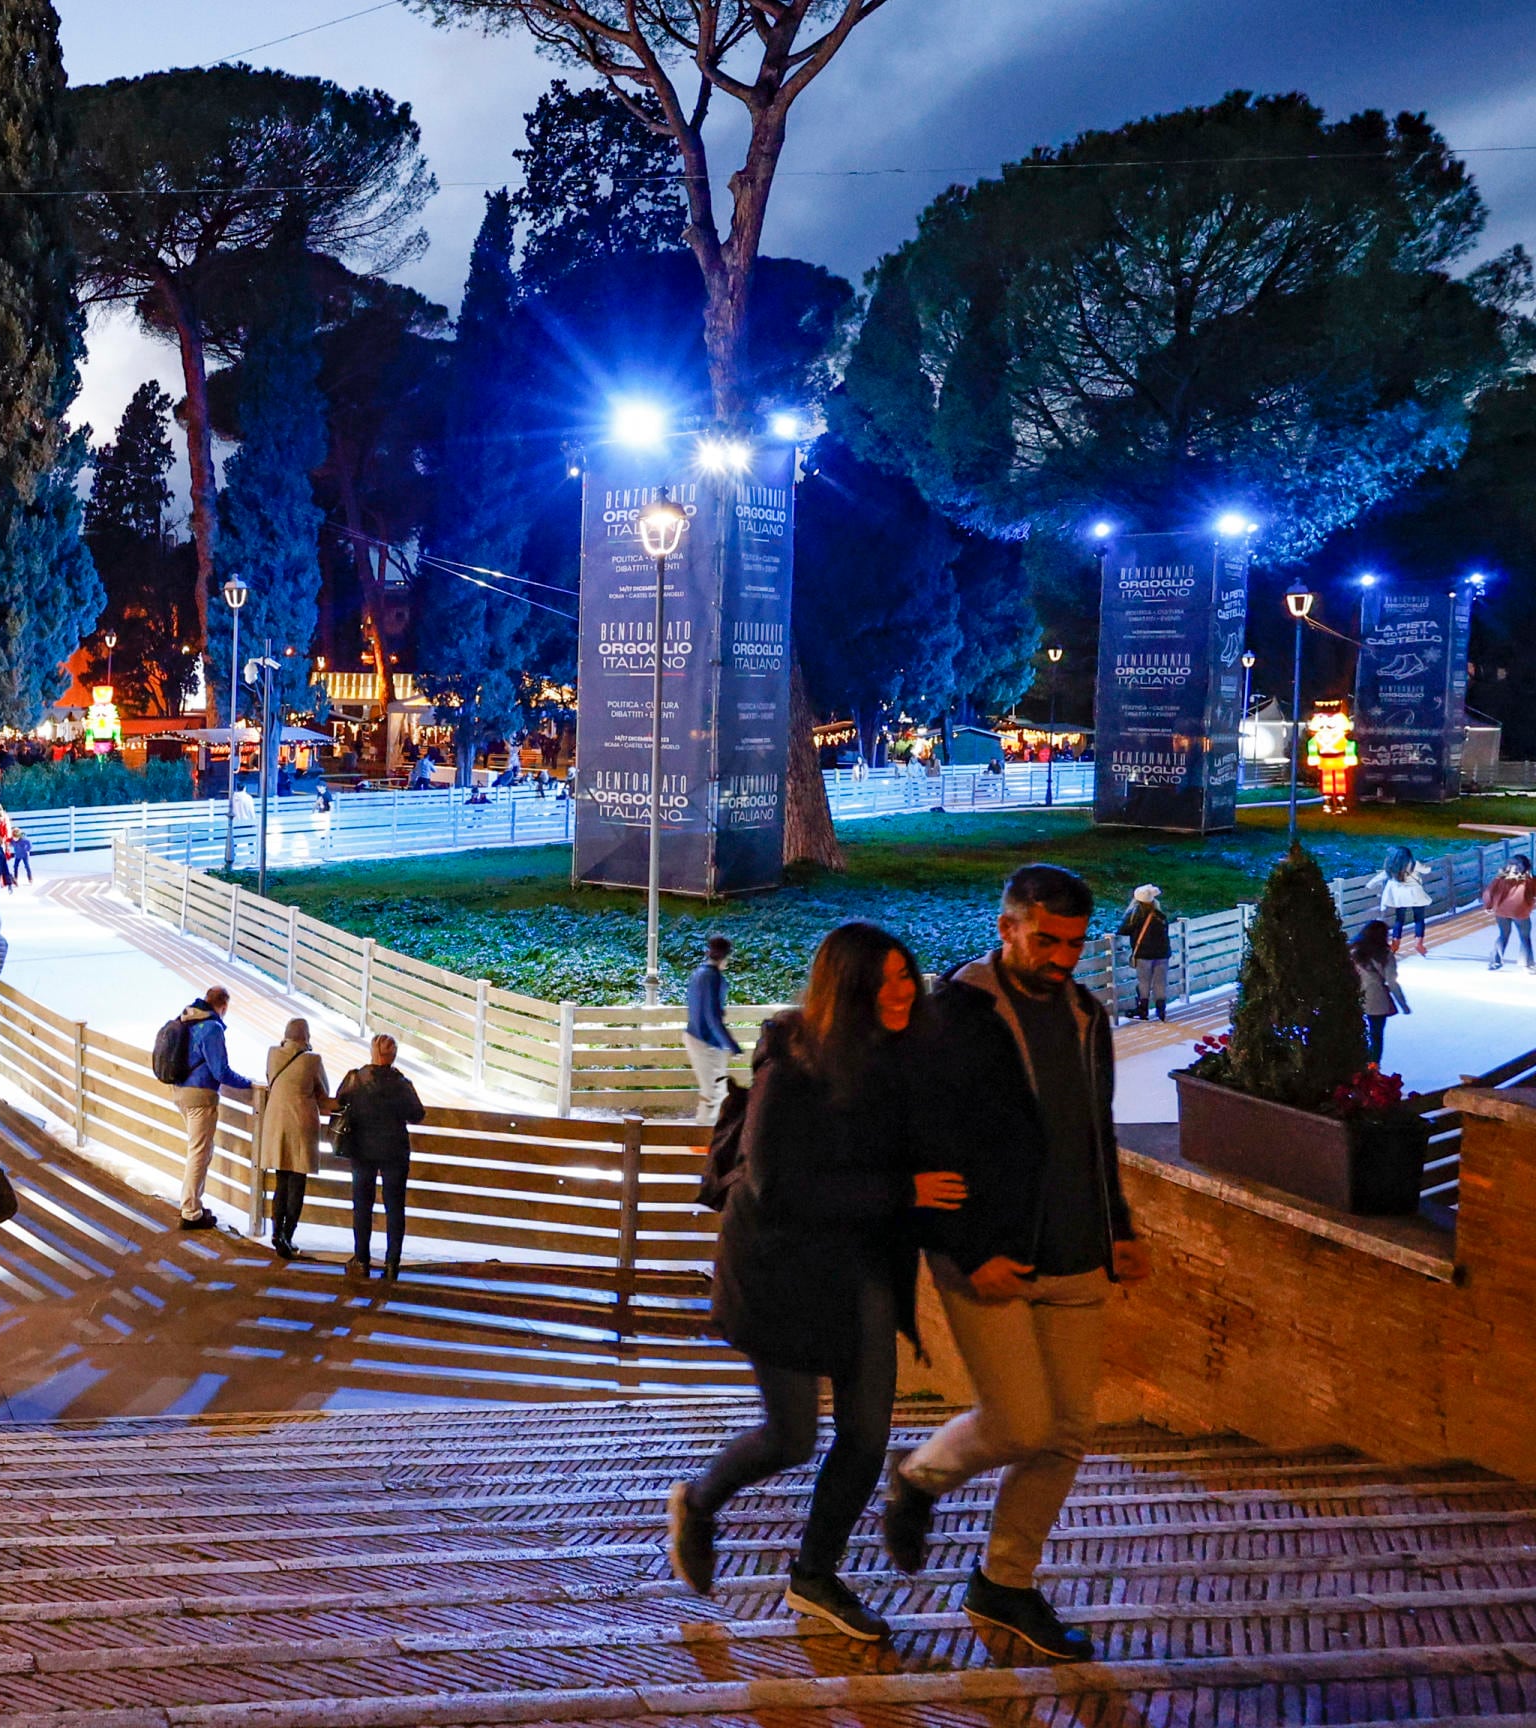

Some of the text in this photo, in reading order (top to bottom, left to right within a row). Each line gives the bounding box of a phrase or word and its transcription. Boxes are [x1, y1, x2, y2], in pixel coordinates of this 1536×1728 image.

[605, 483, 696, 509] BENTORATO
[735, 505, 786, 523] ORGOGLIO
[738, 519, 784, 537] ITALIANO
[612, 555, 644, 564] POLITICA
[1118, 578, 1196, 589] ORGOGLIO
[1121, 588, 1190, 598] ITALIANO
[600, 620, 691, 641] BENTORATO
[1374, 620, 1439, 633] LA PISTA
[1366, 634, 1443, 645] CASTELLO
[733, 643, 784, 656] ORGOGLIO
[734, 657, 781, 671] ITALIANO
[1115, 667, 1192, 676] ORGOGLIO
[1118, 676, 1186, 685] ITALIANO
[607, 701, 639, 709] POLITICA
[610, 710, 675, 719] DIBATTITI ENTI
[1111, 764, 1187, 775] ORGOGLIO
[596, 770, 687, 794] BENTORATO
[728, 794, 778, 808] ORGOGLIO
[730, 808, 774, 823] ITALIANO
